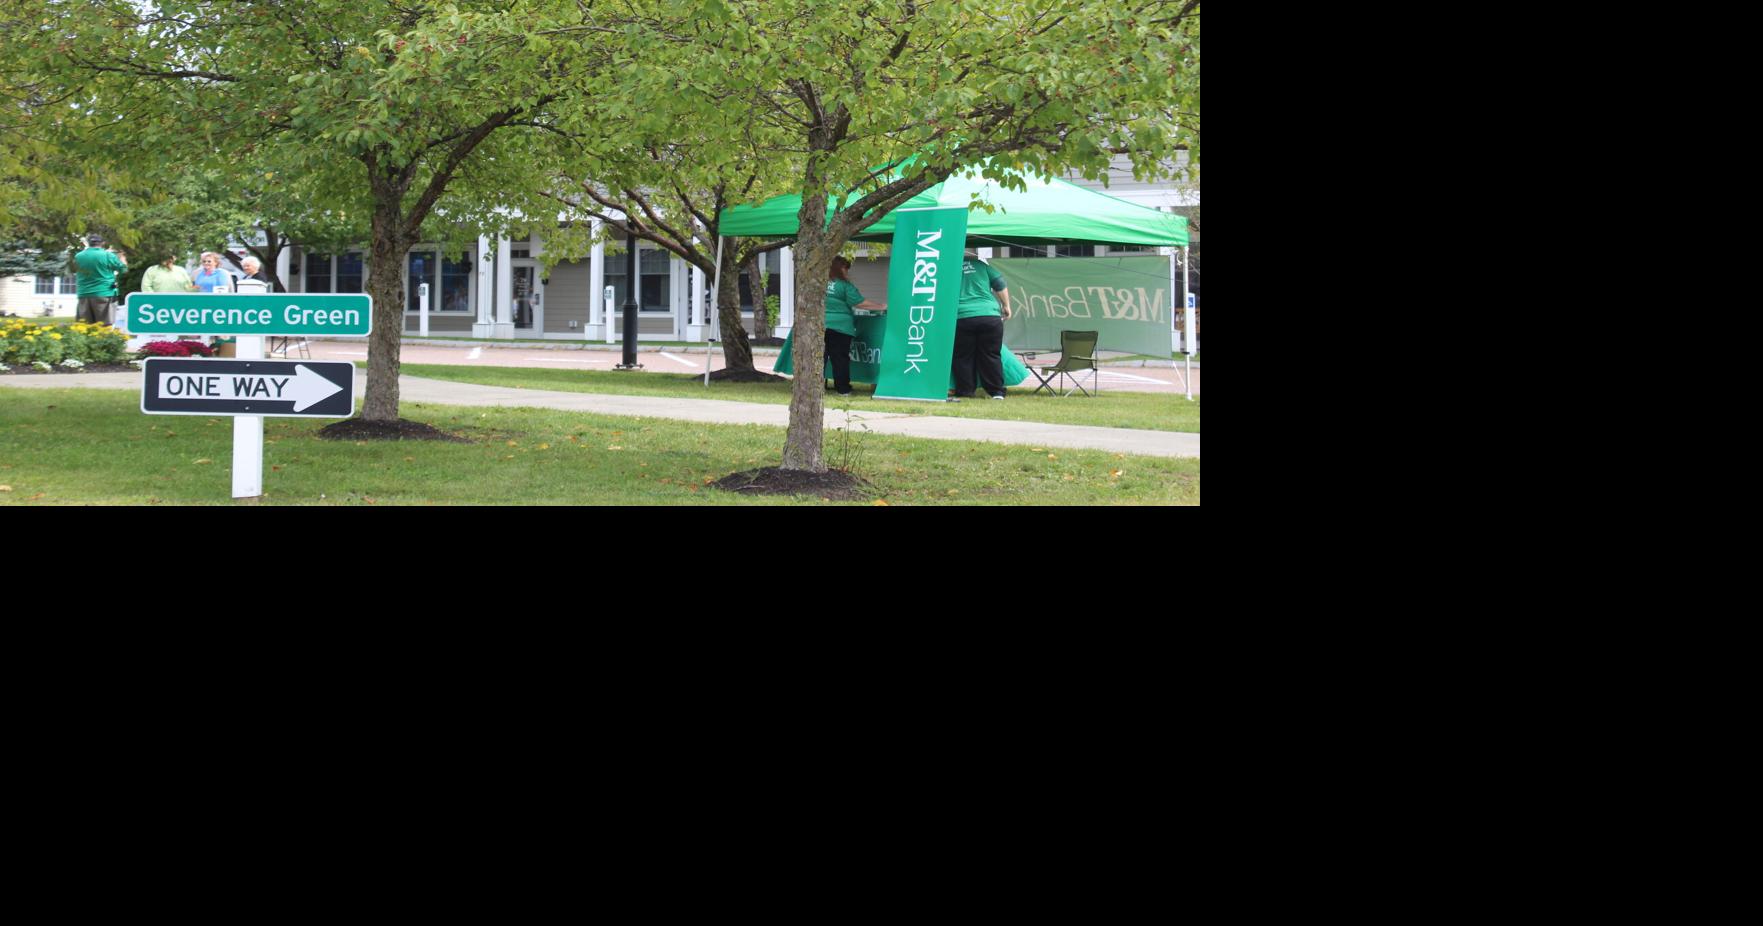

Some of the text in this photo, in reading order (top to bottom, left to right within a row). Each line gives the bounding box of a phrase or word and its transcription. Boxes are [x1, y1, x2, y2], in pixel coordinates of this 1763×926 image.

[904, 228, 942, 374] M&T Bank
[138, 303, 360, 325] Severence Green
[860, 341, 881, 364] Ban
[166, 376, 290, 397] ONE WAY
